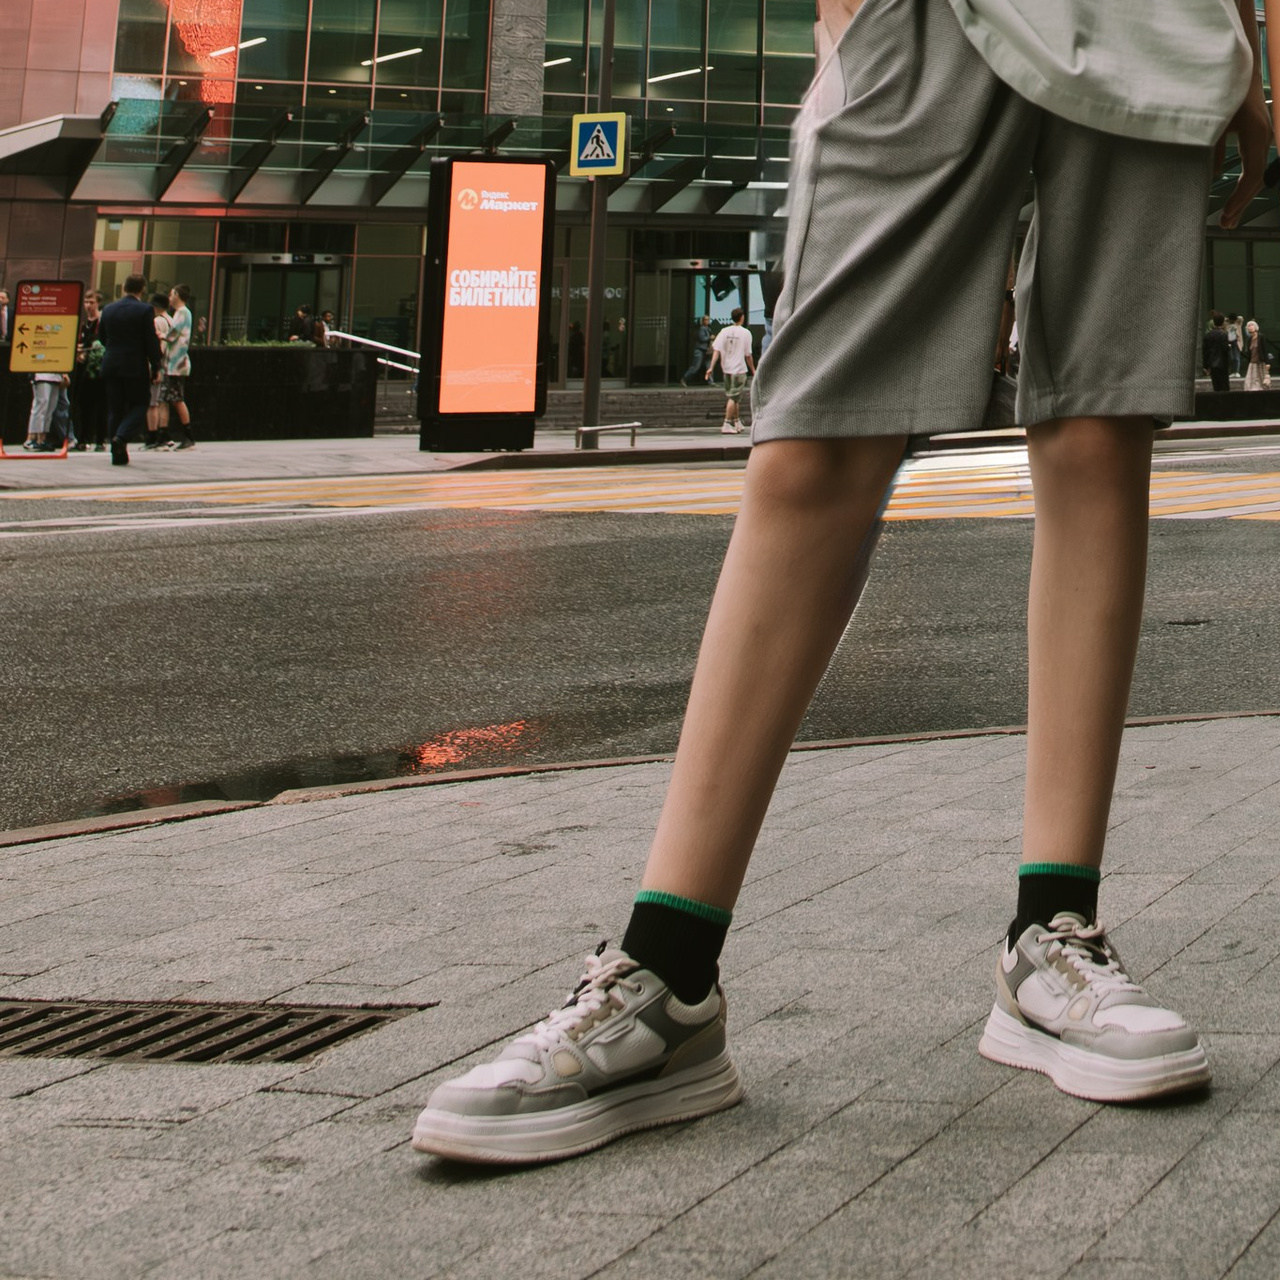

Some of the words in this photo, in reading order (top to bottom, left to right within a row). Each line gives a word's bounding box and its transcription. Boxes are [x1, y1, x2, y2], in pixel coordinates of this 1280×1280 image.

[481, 190, 510, 200] Яндекс
[480, 200, 538, 212] Маркет
[450, 266, 537, 288] СОБИРАЙТЕ
[449, 287, 537, 307] БИЛЕТИКИ
